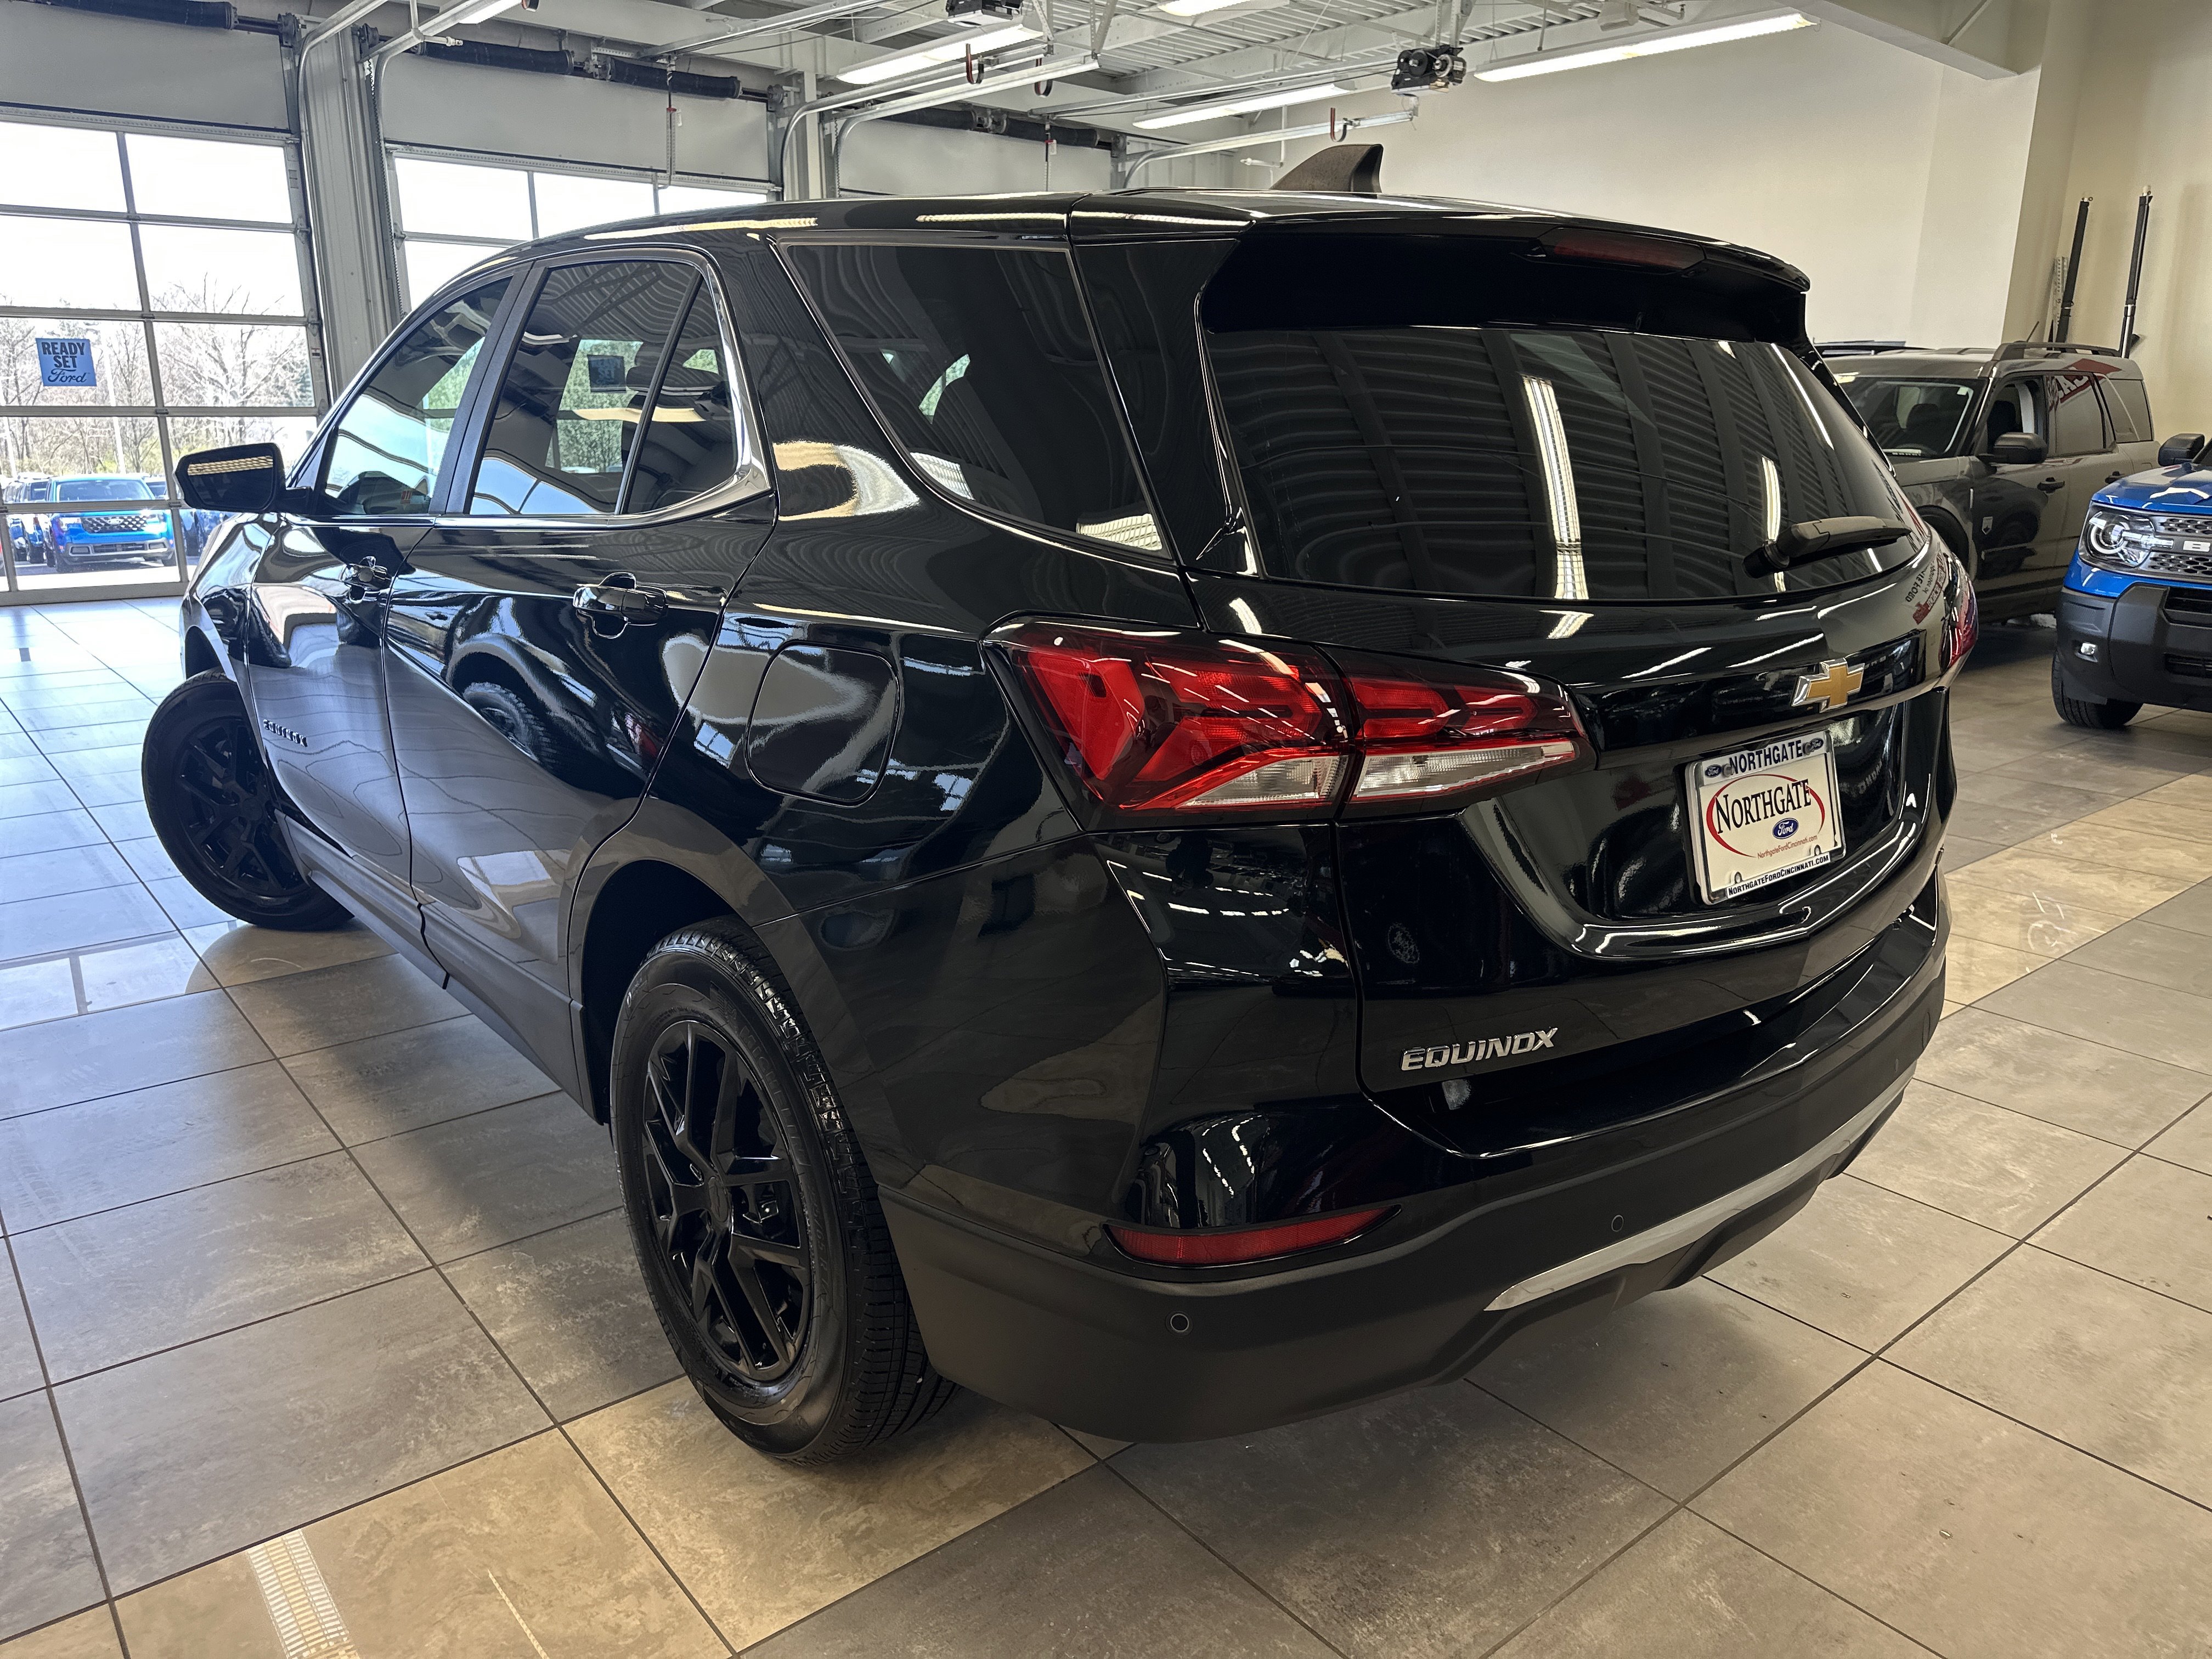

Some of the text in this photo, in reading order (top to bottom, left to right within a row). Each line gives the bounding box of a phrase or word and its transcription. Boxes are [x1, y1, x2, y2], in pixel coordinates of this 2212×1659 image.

[41, 342, 85, 356] READY
[53, 356, 77, 368] SET
[48, 368, 88, 383] Ford
[1729, 740, 1804, 775] NORTHGATE
[1714, 778, 1812, 834] NORTHGATE
[1777, 821, 1795, 837] Ford
[1400, 1027, 1559, 1071] EQUINOX
